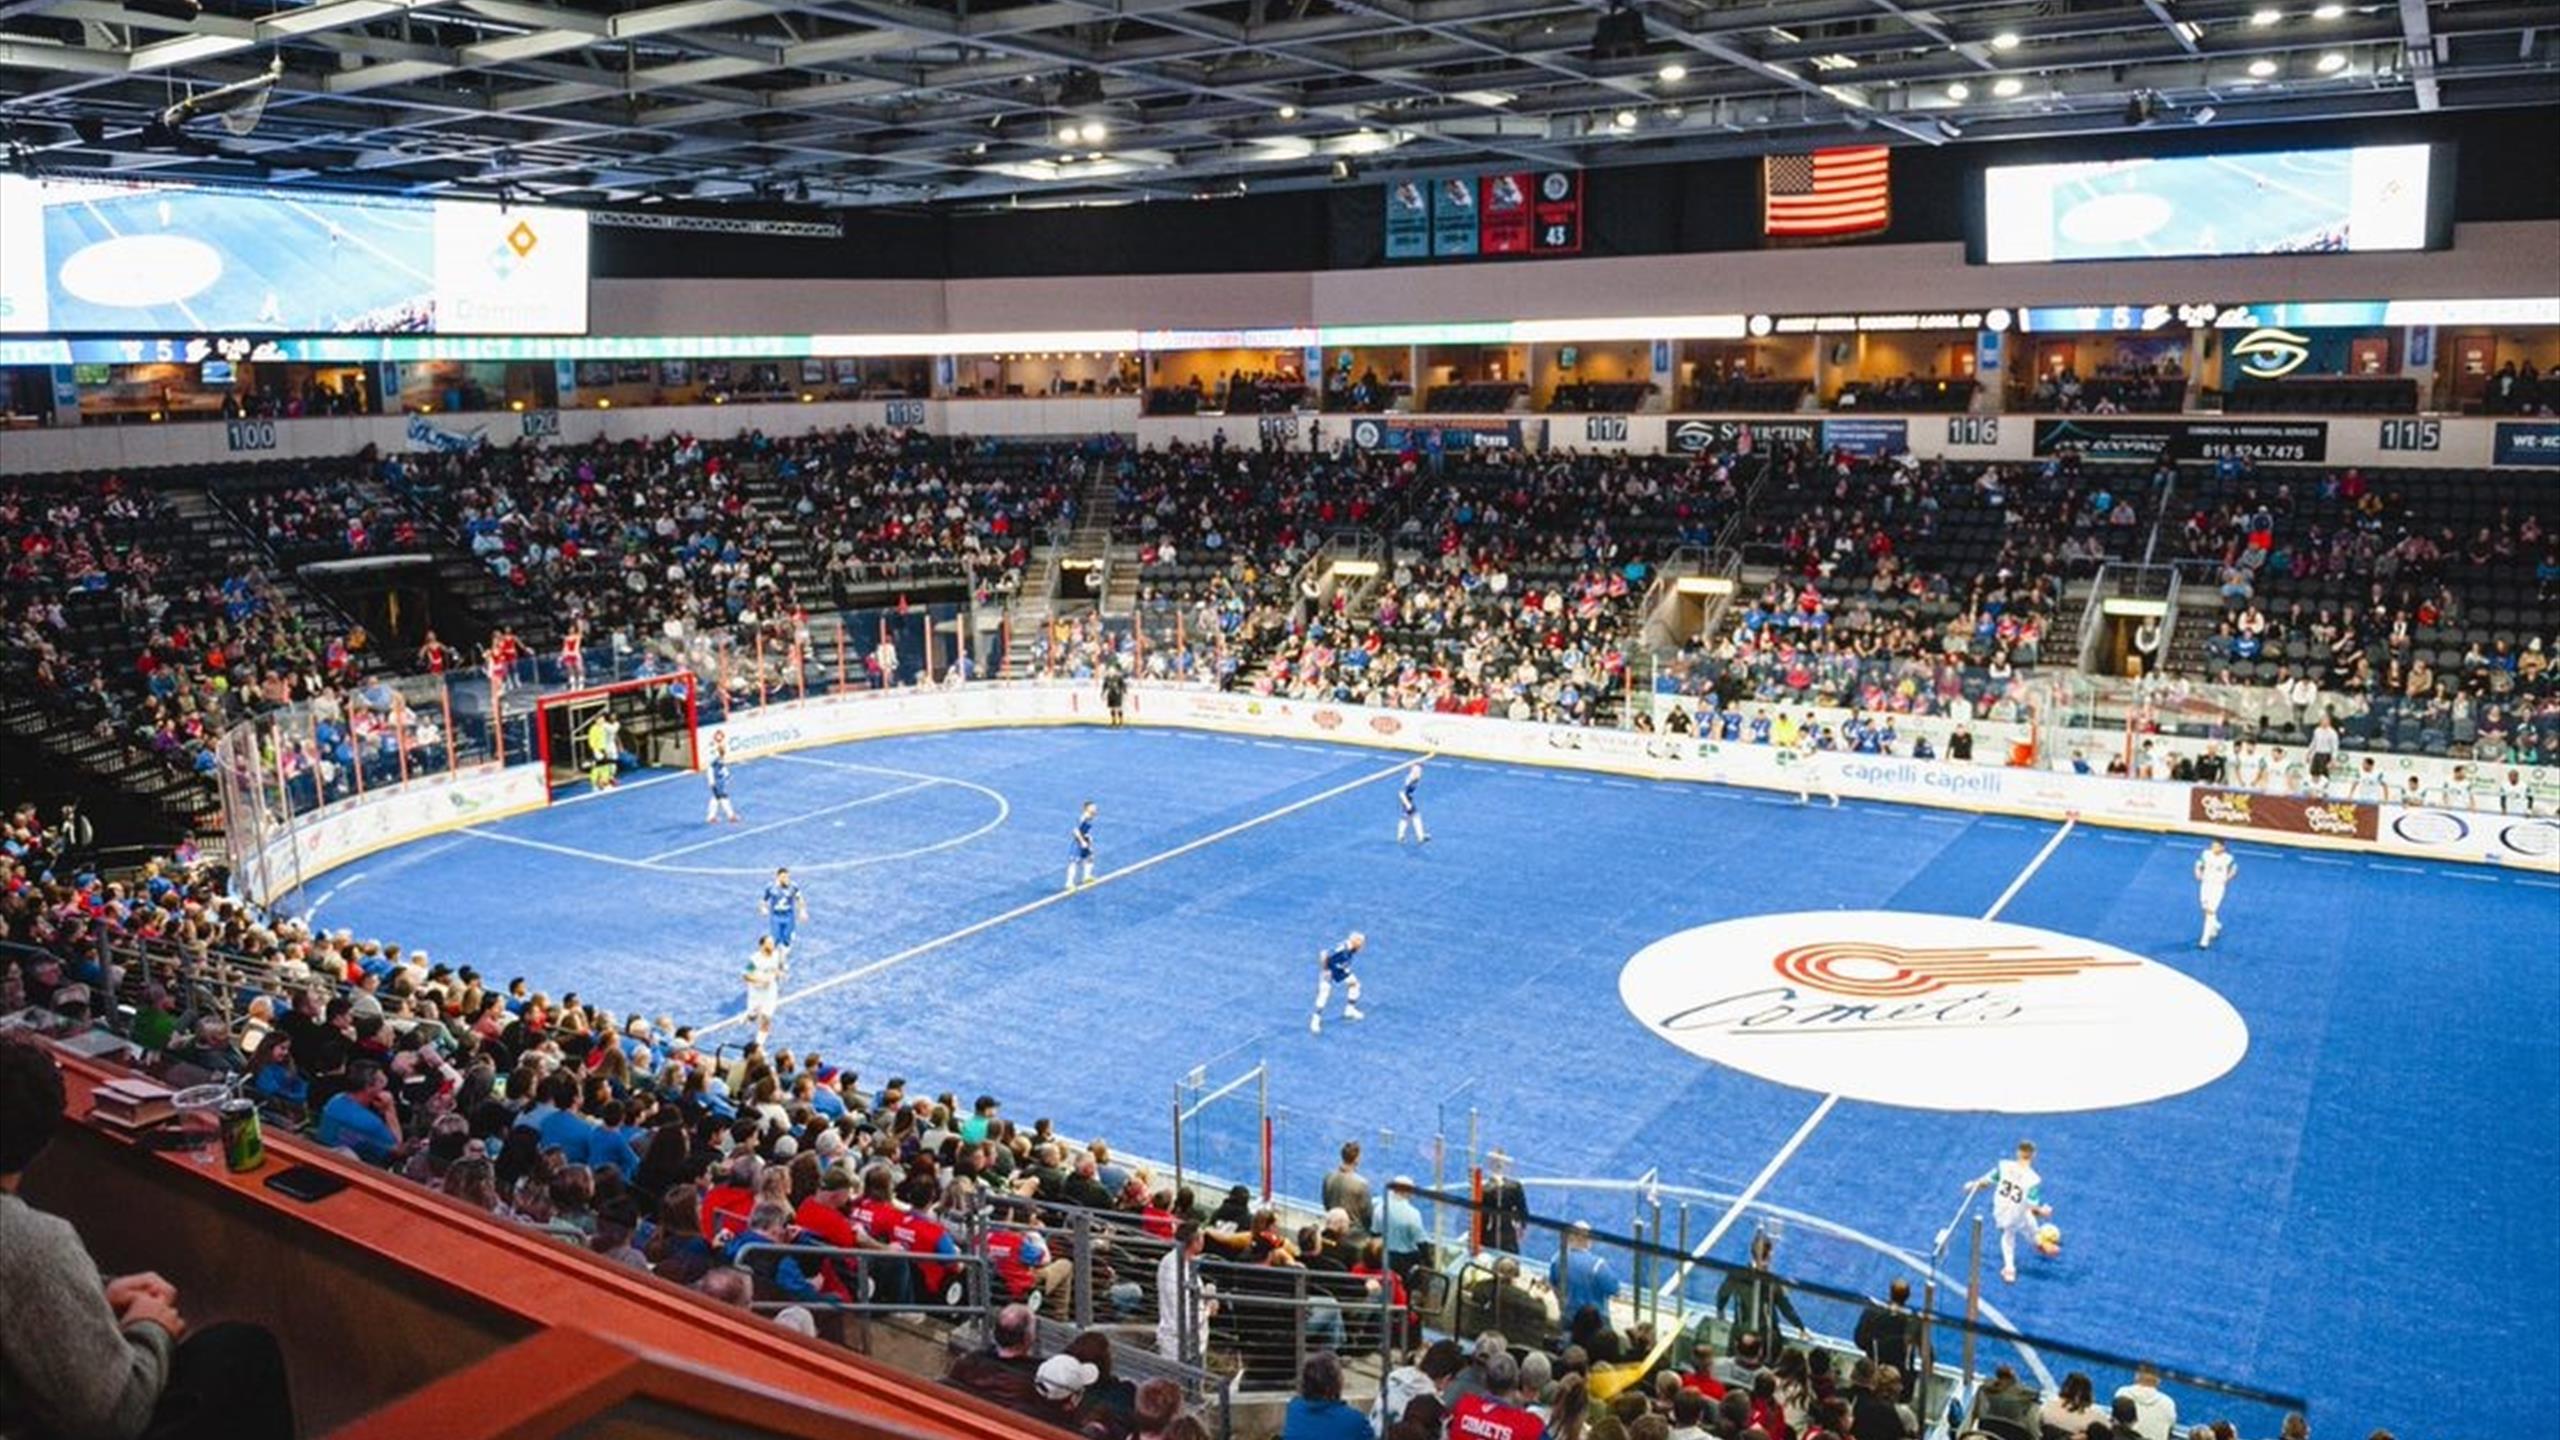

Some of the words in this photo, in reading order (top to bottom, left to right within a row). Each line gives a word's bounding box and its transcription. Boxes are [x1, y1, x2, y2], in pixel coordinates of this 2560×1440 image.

[1546, 225, 1566, 246] 43
[156, 341, 173, 360] 5
[889, 405, 923, 424] 119
[230, 426, 275, 448] 100
[1261, 419, 1297, 437] 118
[1589, 418, 1627, 440] 117
[1951, 419, 1996, 443] 116
[2383, 422, 2438, 448] 115
[2202, 443, 2305, 459] 816.524.7475
[1841, 763, 1917, 785] capelli
[1923, 769, 2001, 793] capelli
[1659, 985, 2024, 1031] Comets
[1999, 1179, 2024, 1205] 33
[1460, 1414, 1514, 1440] COMETS
